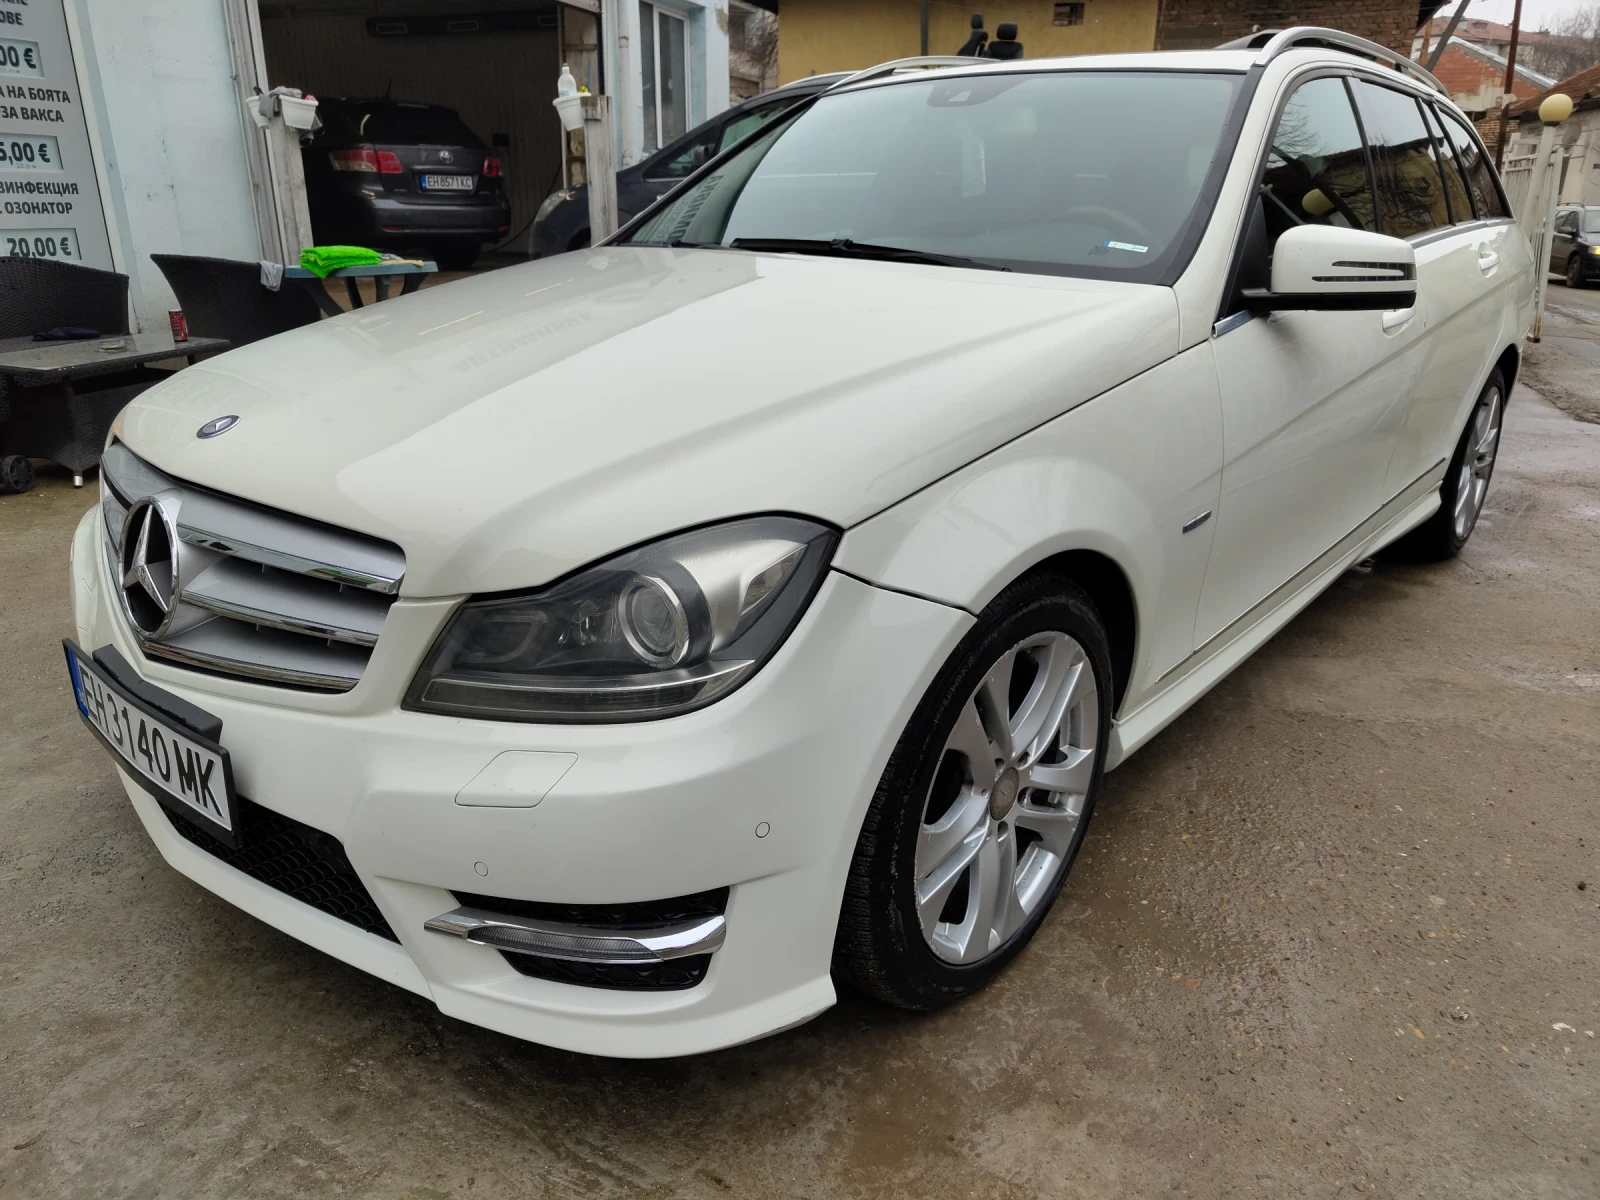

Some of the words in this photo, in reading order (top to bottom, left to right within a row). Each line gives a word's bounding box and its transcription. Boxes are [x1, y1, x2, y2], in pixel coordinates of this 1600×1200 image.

[23, 47, 37, 69] €
[6, 85, 27, 99] НА
[28, 87, 71, 103] БОЯТА
[20, 107, 64, 122] ВАКСА
[38, 143, 51, 163] €
[4, 201, 73, 214] ОЗОНАТОР
[7, 237, 57, 258] 20,00
[60, 236, 72, 256] €
